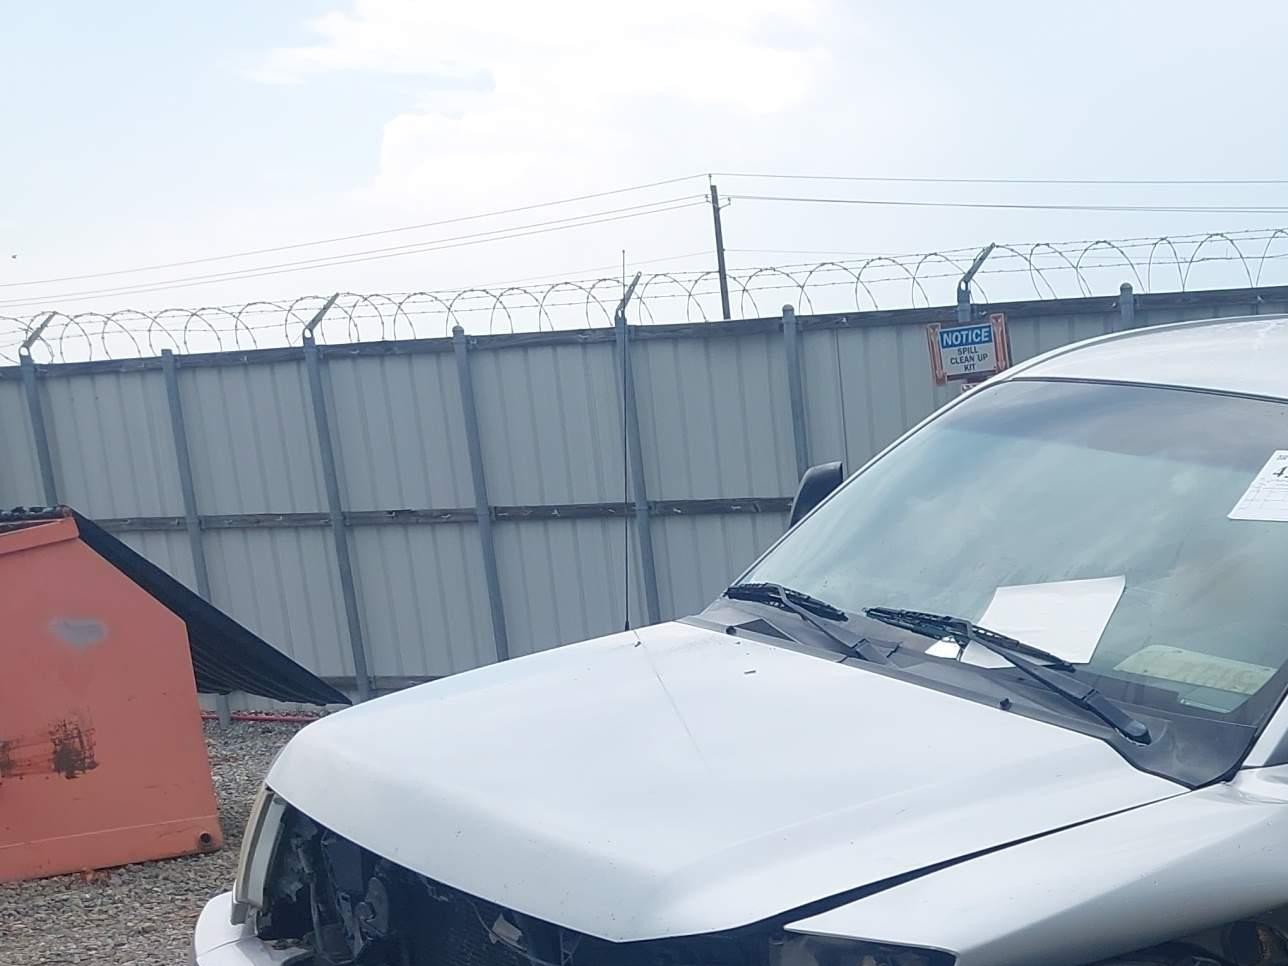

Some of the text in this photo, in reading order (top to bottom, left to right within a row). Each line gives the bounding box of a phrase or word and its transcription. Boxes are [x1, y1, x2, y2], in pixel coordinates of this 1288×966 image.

[943, 328, 989, 347] NOTICE
[957, 345, 979, 356] SPILL
[950, 353, 988, 365] CLEAN UP
[963, 363, 976, 372] KIT
